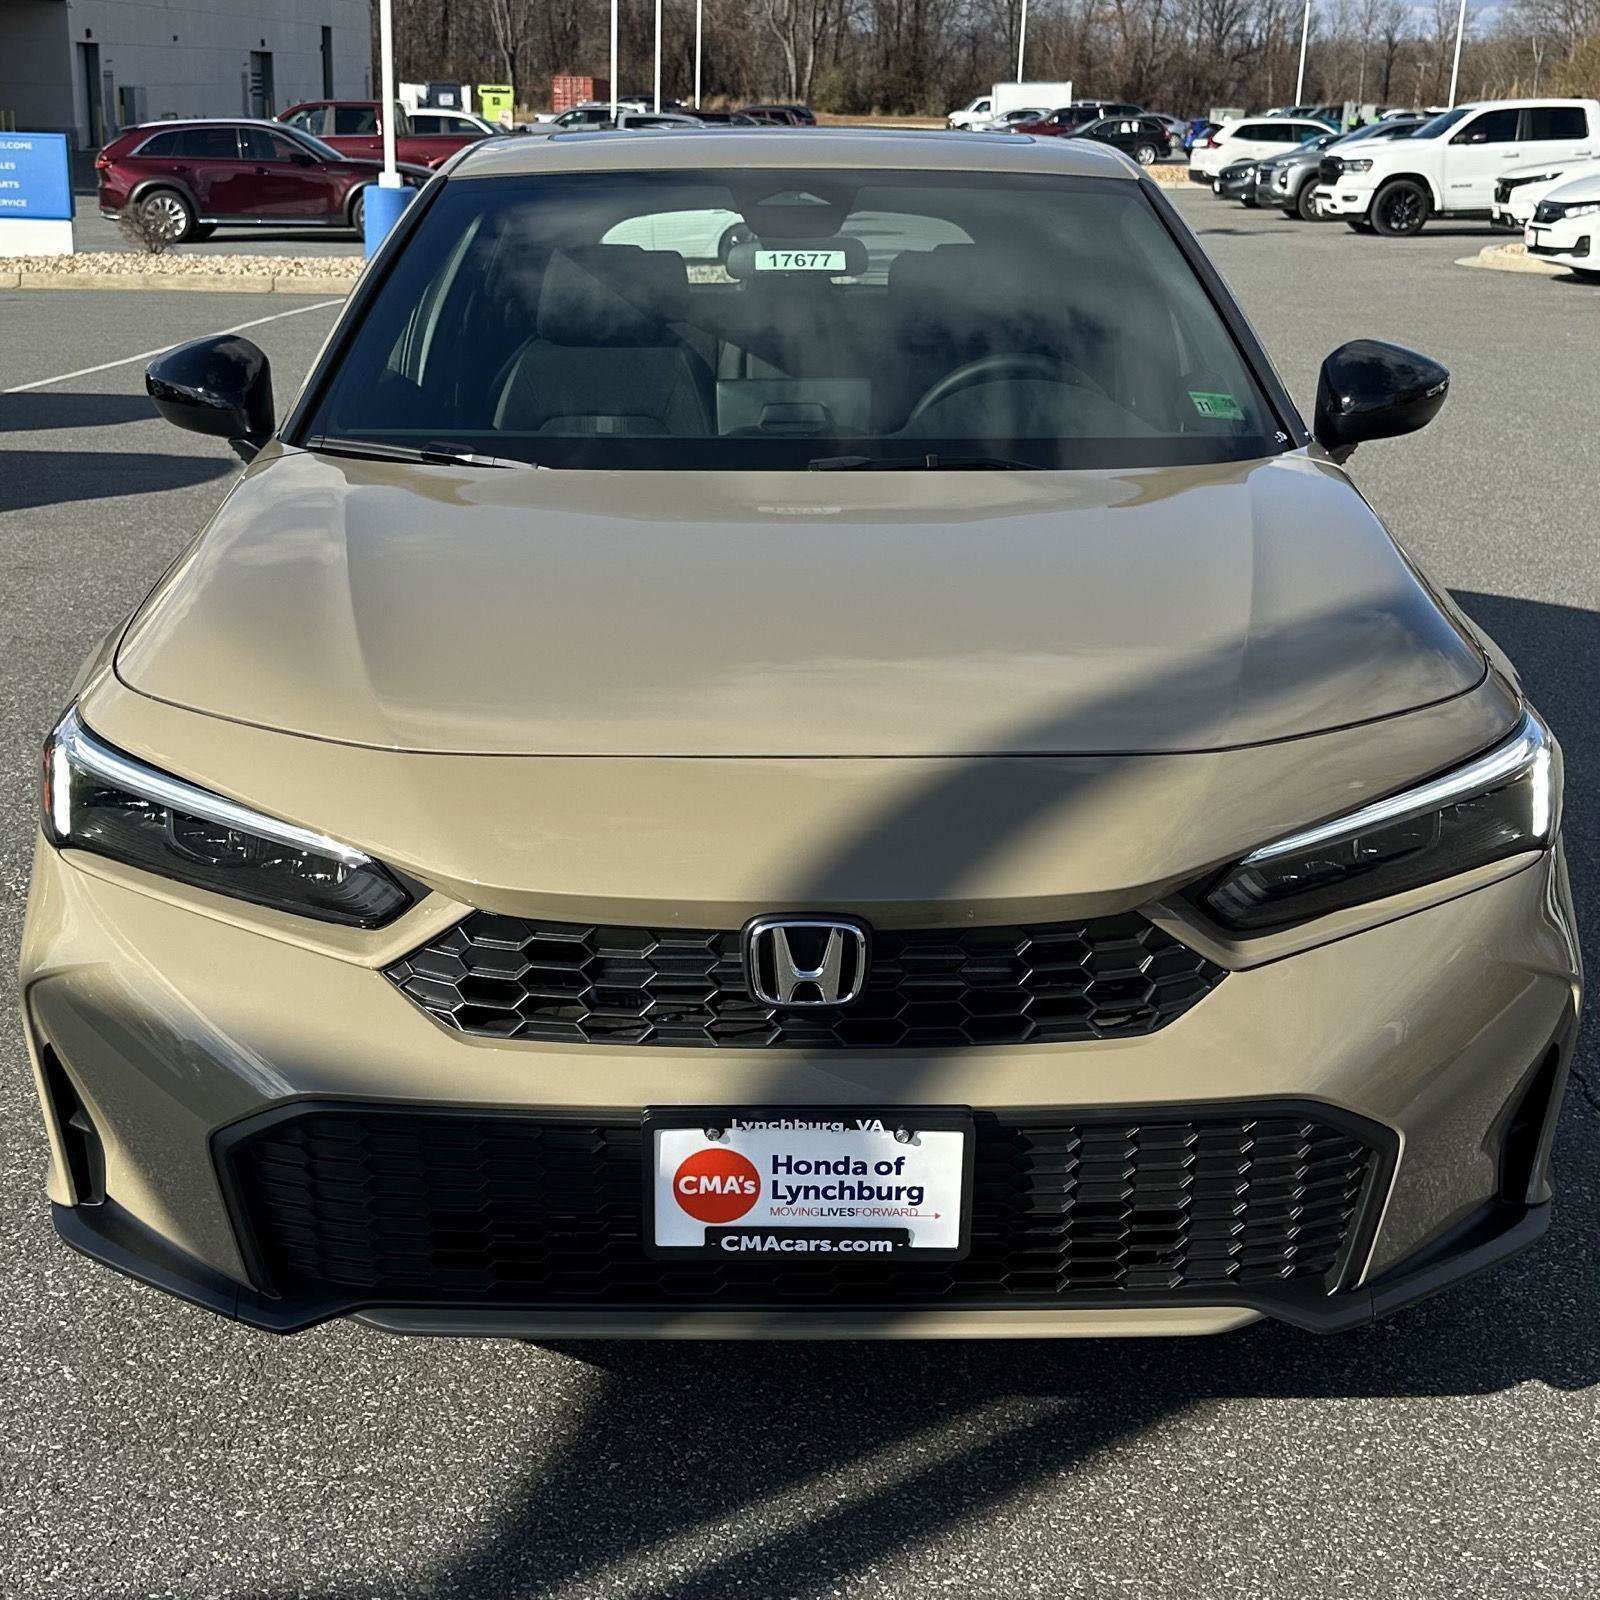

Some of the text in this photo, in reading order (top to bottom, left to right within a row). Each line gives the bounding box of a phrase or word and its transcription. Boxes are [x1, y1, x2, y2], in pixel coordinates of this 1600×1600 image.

[768, 253, 832, 268] 17677
[855, 1119, 886, 1134] VA
[771, 1154, 906, 1176] Honda of
[678, 1174, 757, 1196] CMA's
[771, 1179, 925, 1207] Lynchburg
[720, 1234, 893, 1253] CMAcars.com
